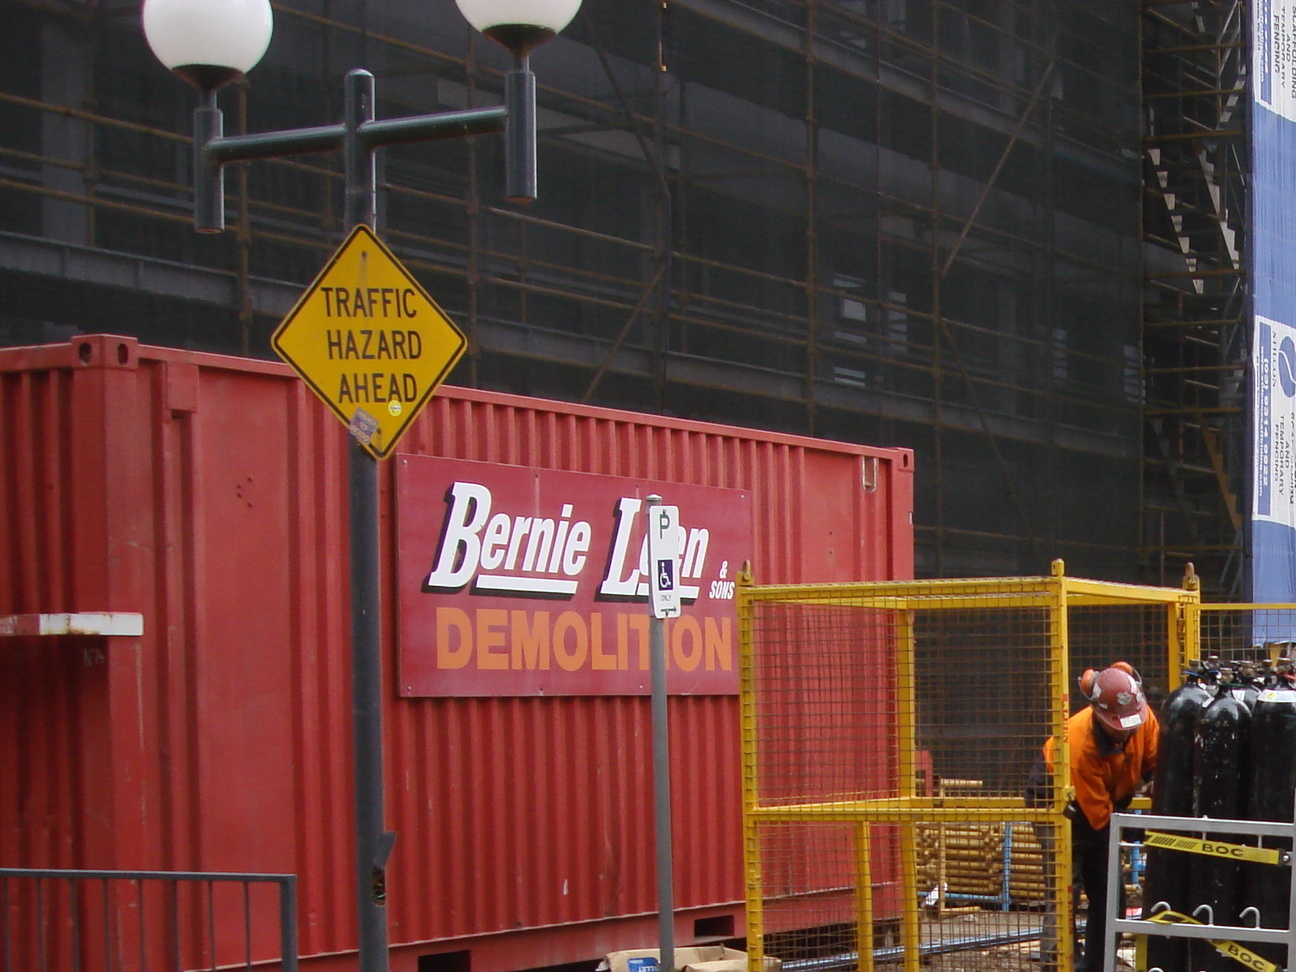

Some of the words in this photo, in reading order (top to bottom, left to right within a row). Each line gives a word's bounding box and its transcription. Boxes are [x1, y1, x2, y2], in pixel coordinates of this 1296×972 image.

[320, 287, 418, 319] TRAFFIC
[326, 329, 422, 360] HAZARD
[338, 373, 418, 404] AHEAD
[428, 481, 592, 588] Bernie
[659, 513, 670, 540] P
[719, 560, 728, 580] &
[709, 580, 736, 600] SONS
[436, 606, 732, 672] DEMOLITON
[1202, 842, 1244, 858] BOC
[1227, 944, 1266, 971] BOC
